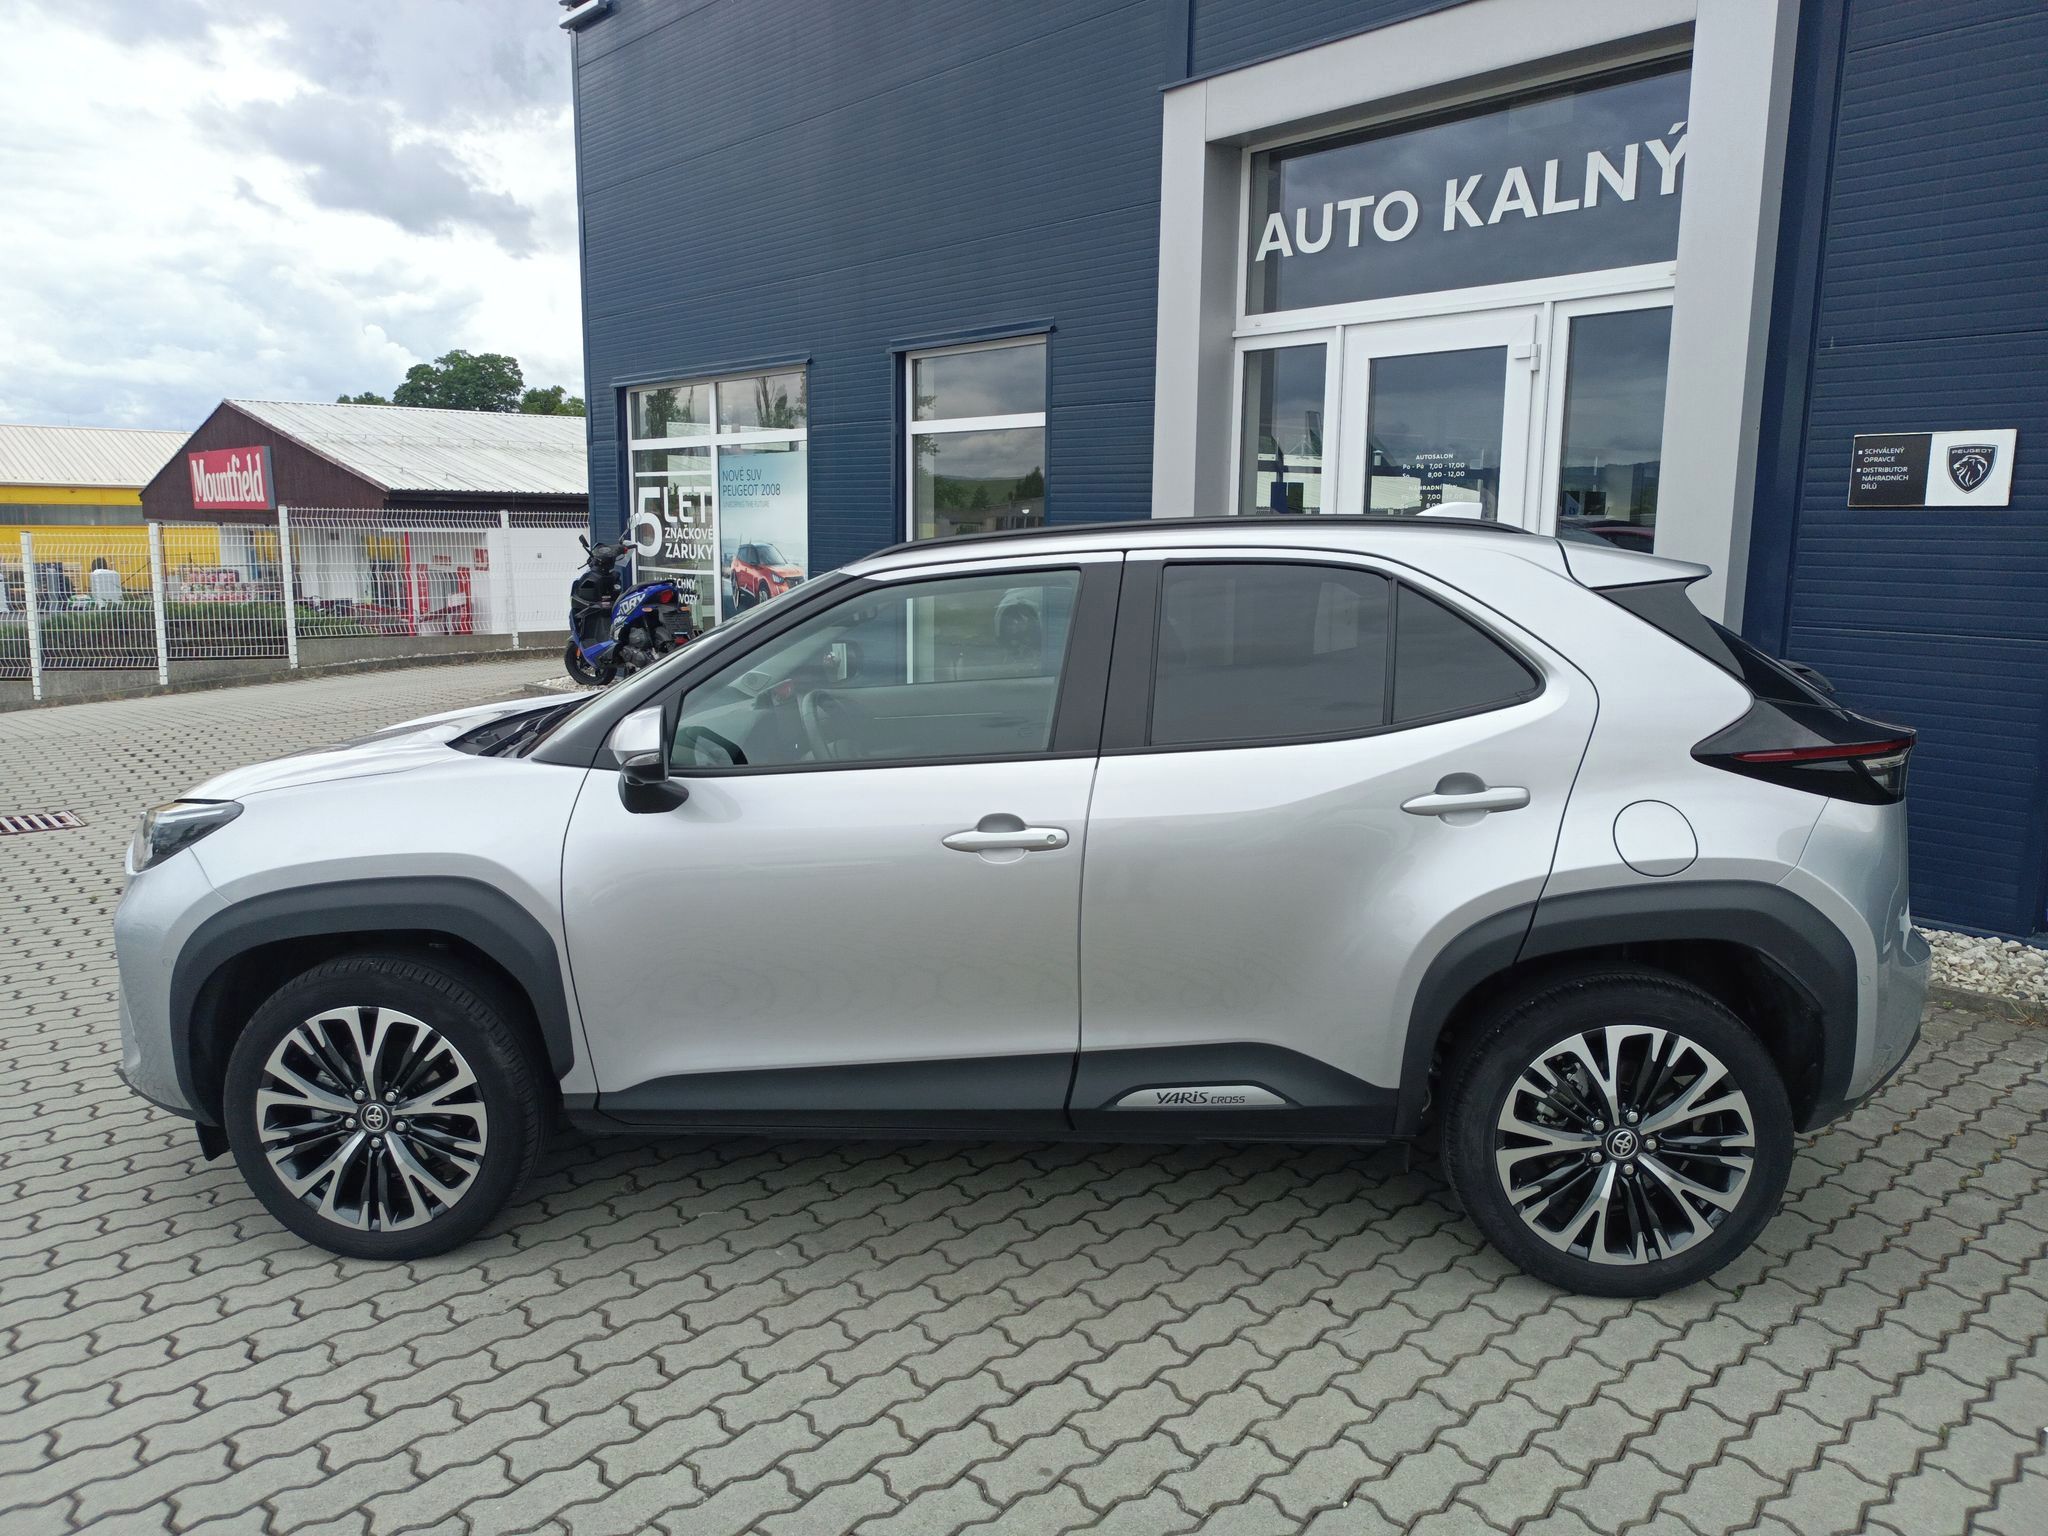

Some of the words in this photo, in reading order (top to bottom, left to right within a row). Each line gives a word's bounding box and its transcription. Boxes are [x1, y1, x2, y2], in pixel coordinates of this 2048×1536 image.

[1255, 190, 1419, 262] AUTO
[1443, 121, 1688, 232] KALNÝ
[1864, 445, 1905, 455] SCHVÁLENÝ
[191, 453, 265, 502] Mountfield
[722, 466, 744, 482] NOVÉ
[746, 469, 762, 481] SUV
[722, 484, 759, 497] PEUGEOT
[761, 483, 781, 496] 2008
[637, 486, 663, 558] 5
[663, 486, 712, 523] LET
[665, 524, 714, 540] ZNAČKOVÉ
[665, 538, 714, 560] ZÁRUKY
[1210, 1095, 1246, 1104] CROSS
